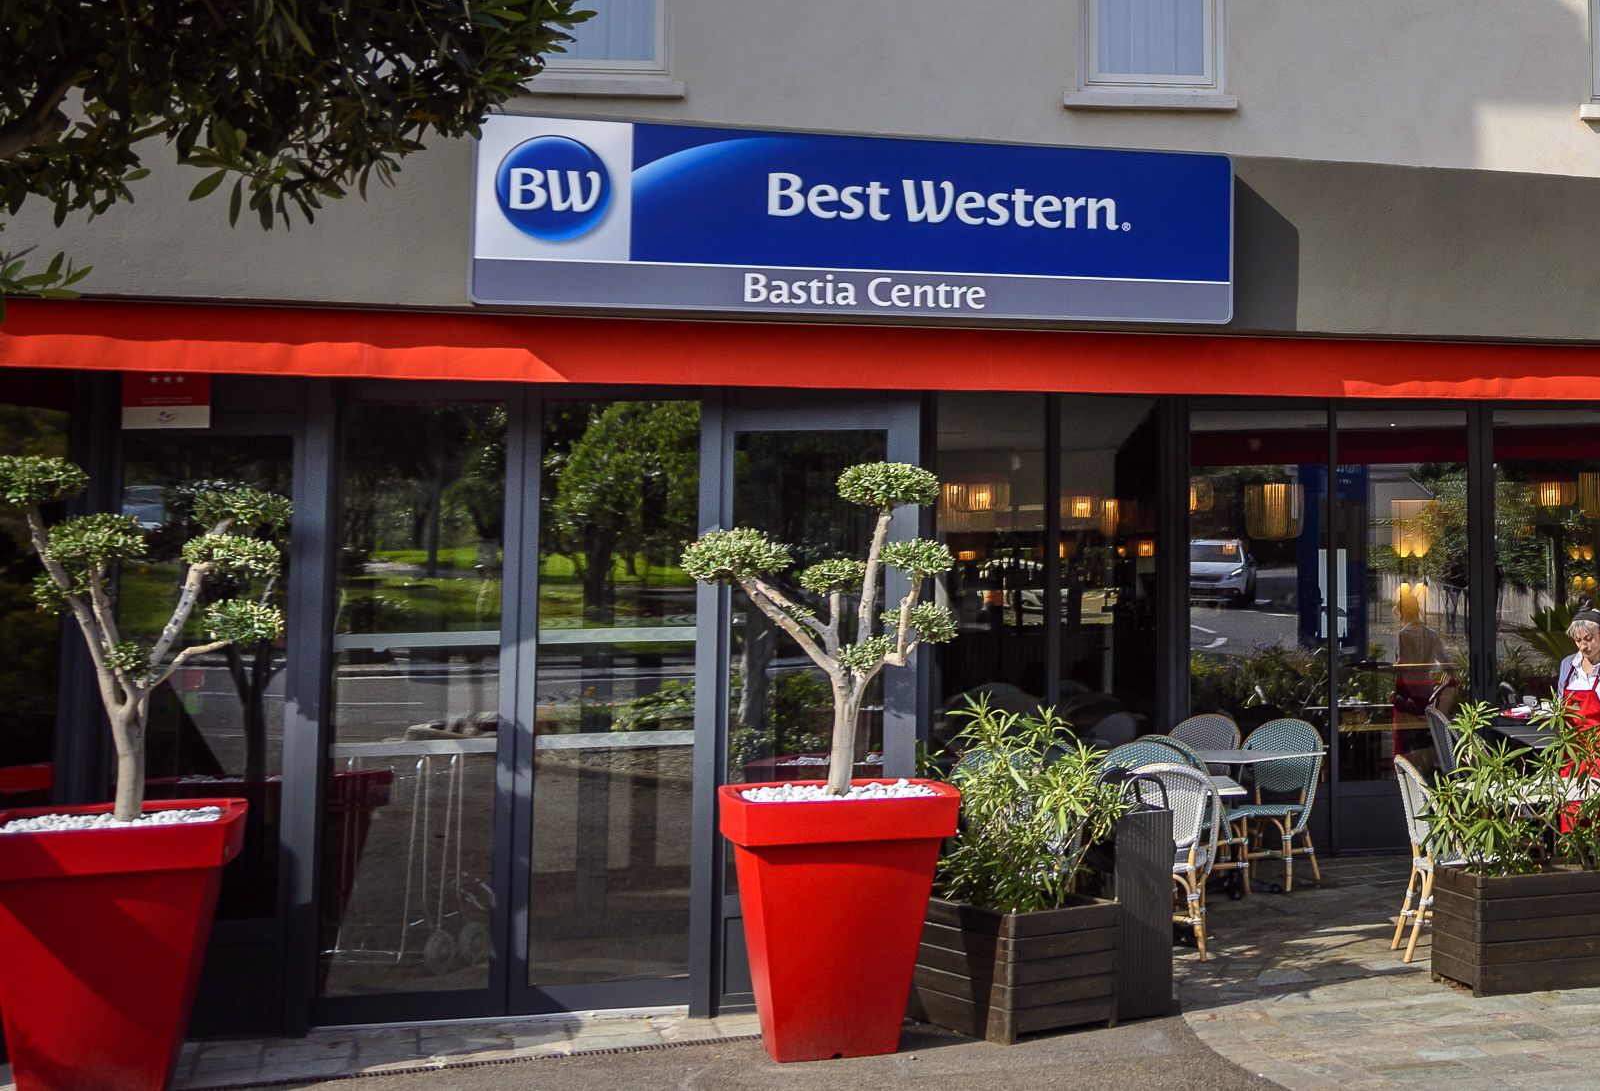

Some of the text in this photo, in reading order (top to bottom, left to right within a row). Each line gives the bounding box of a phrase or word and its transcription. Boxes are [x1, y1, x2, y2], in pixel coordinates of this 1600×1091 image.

[508, 166, 601, 214] BW
[767, 172, 891, 222] Best
[743, 272, 987, 310] Bastia Centre
